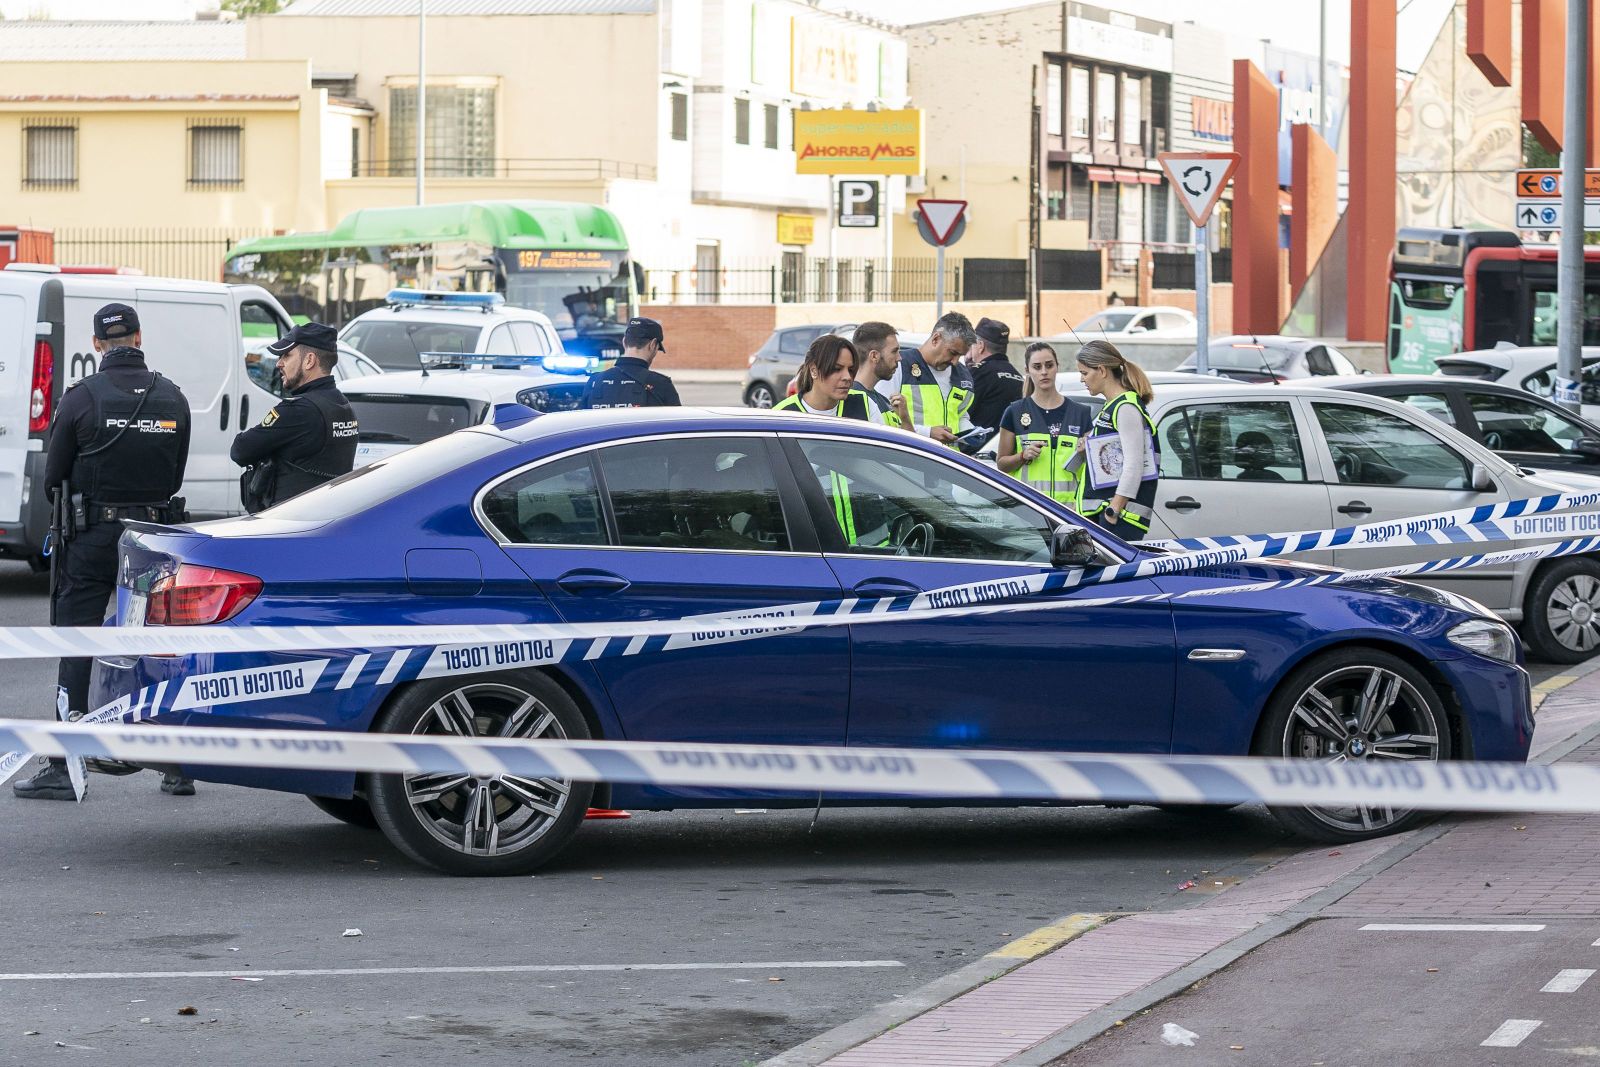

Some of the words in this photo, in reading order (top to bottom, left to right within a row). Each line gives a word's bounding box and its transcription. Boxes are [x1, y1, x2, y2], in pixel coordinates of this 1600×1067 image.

[842, 182, 873, 215] P
[106, 419, 161, 428] POLICIA
[1195, 548, 1248, 569] POLICIA
[925, 587, 971, 609] LOCAL
[974, 580, 1030, 601] POLICIA
[441, 646, 490, 670] LOCAL
[495, 640, 554, 664] POLICIA
[191, 676, 239, 701] LOCAL
[243, 668, 305, 694] POLICIA
